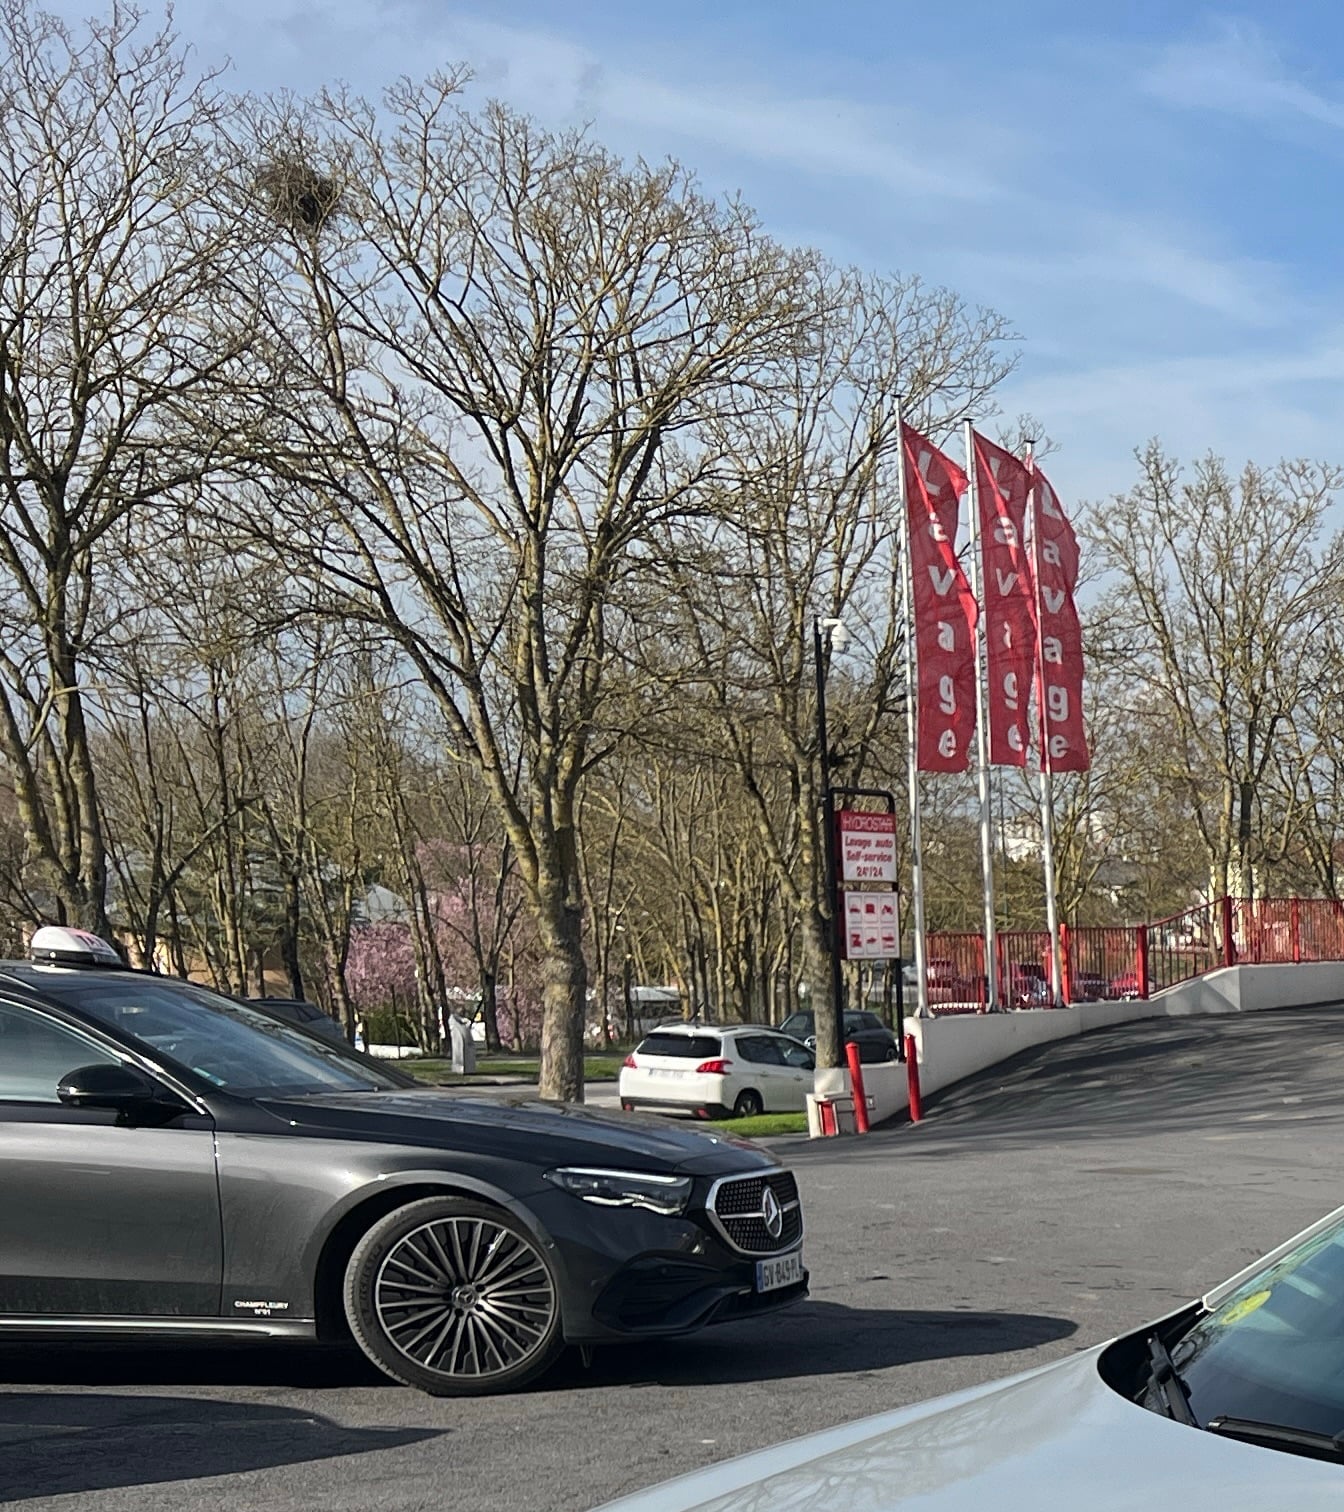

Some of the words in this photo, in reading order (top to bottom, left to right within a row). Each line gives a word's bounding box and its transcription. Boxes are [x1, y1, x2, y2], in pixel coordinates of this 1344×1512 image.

[1041, 481, 1068, 758] Lavage
[842, 815, 893, 832] HYDROSTAR
[845, 836, 872, 850] Lavage
[846, 850, 892, 862] Self-service
